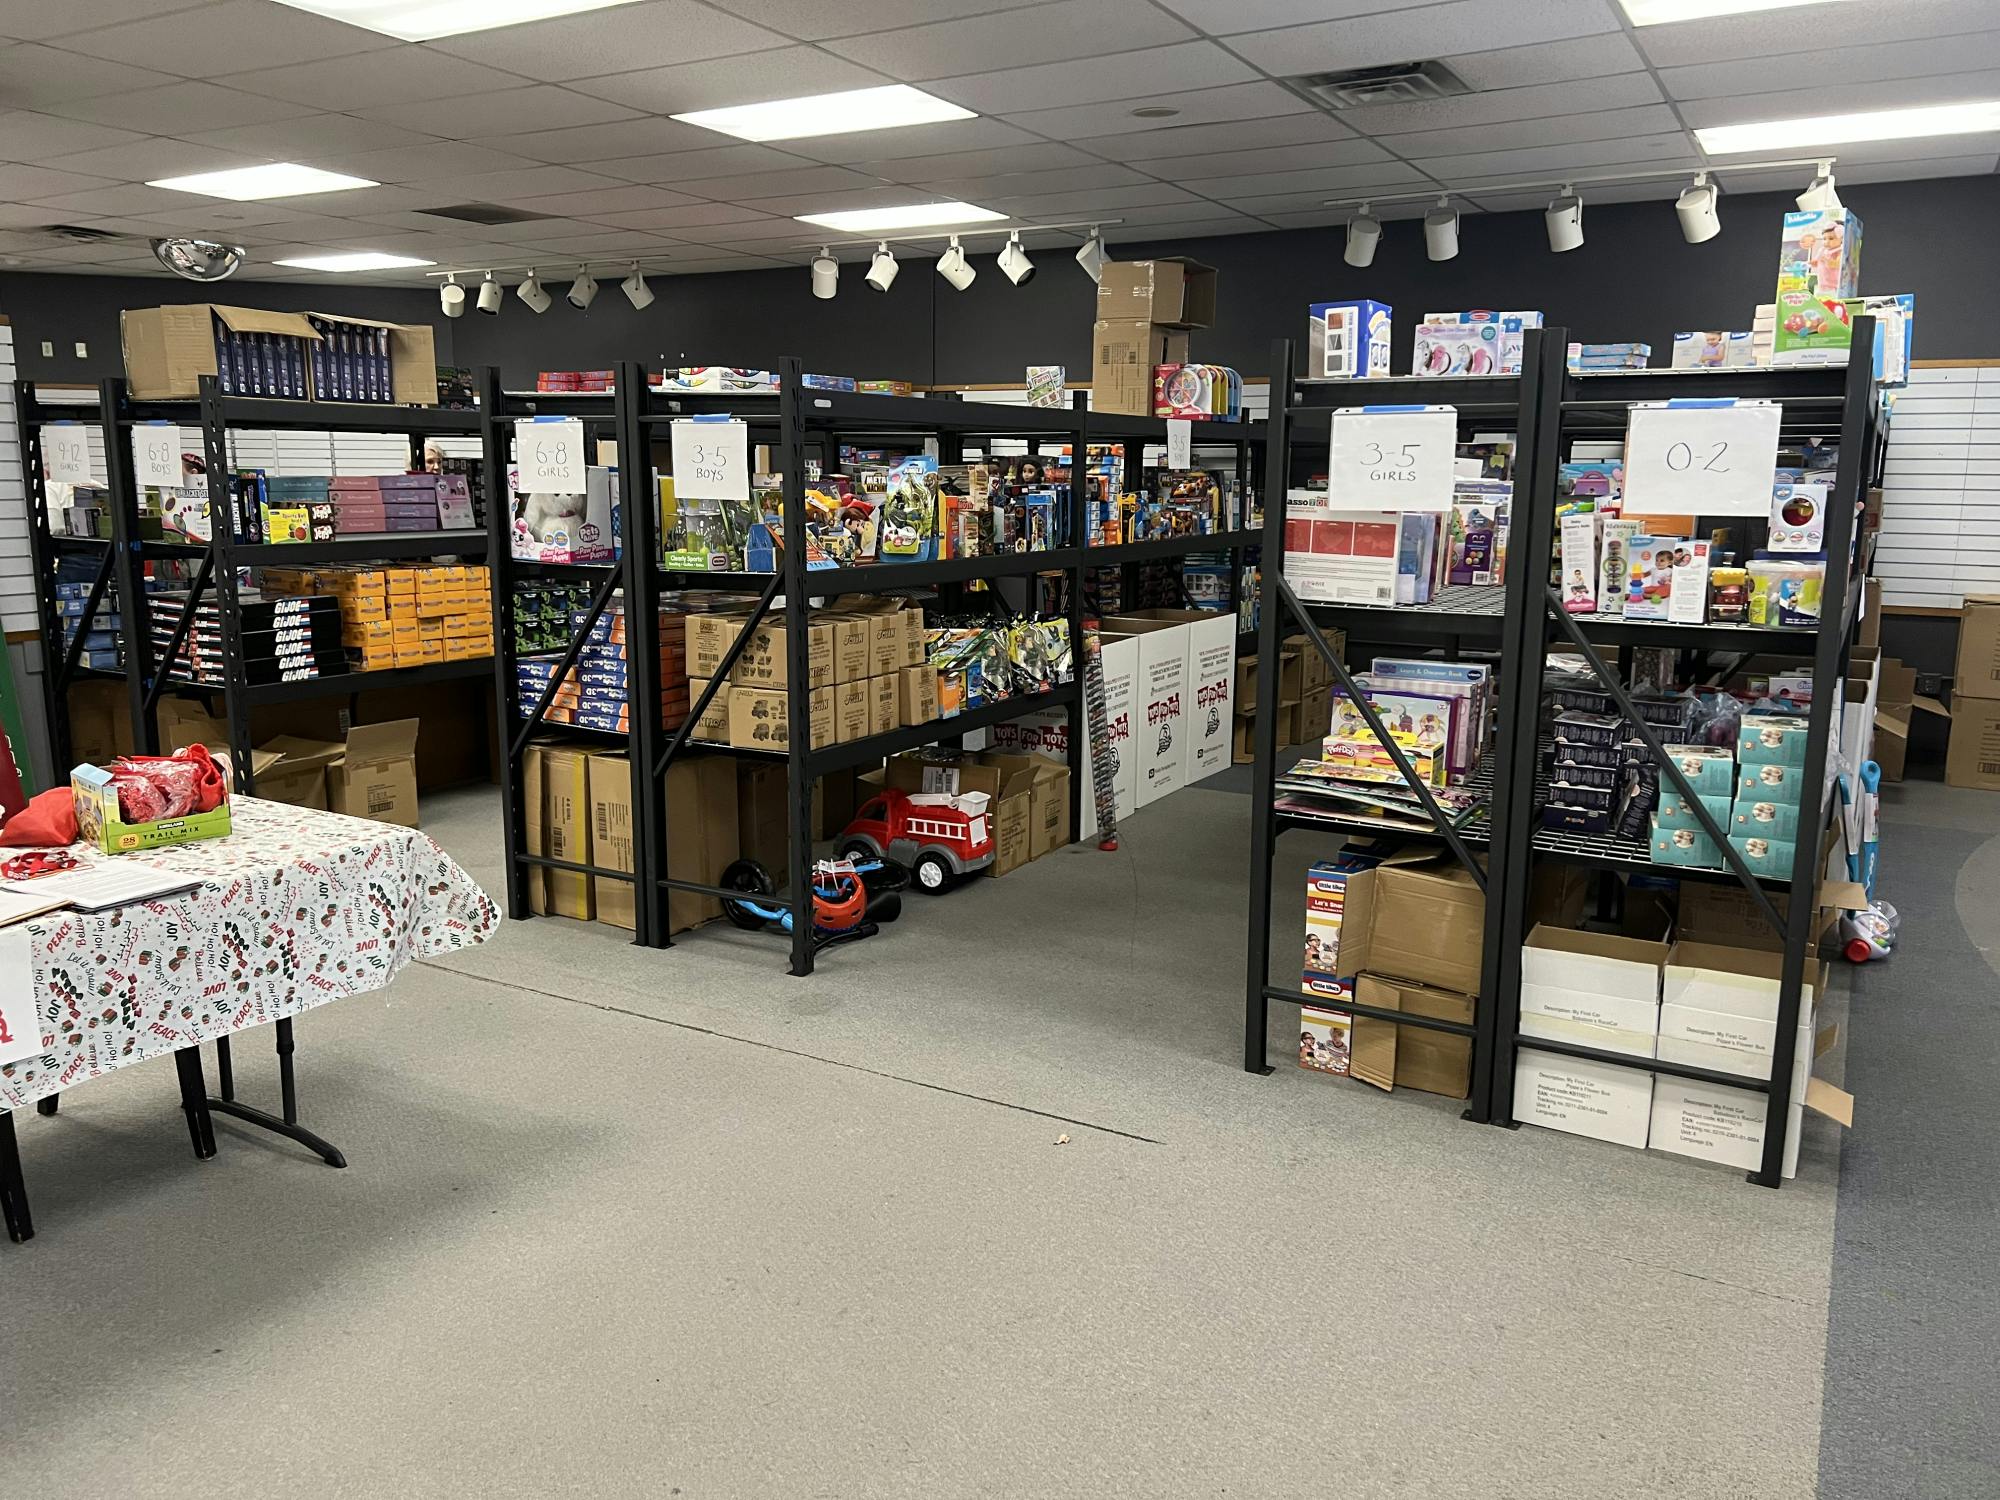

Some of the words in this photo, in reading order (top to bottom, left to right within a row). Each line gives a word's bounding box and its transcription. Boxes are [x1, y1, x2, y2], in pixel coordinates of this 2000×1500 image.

[1033, 373, 1050, 385] Farm
[58, 441, 82, 463] 9-12
[148, 442, 170, 463] 6-8
[536, 441, 567, 465] 6-8
[690, 444, 732, 468] 3-5
[1360, 442, 1422, 468] 3-5
[151, 463, 171, 475] BOYS
[537, 466, 570, 478] GIRLS
[696, 468, 724, 483] BOYS
[1370, 470, 1417, 482] GIRLS
[312, 504, 333, 520] Jenga
[313, 525, 333, 540] Jenga
[580, 527, 599, 537] Pets
[687, 555, 702, 563] Sports
[995, 727, 1017, 739] TOYS
[1022, 731, 1039, 743] FOR
[1044, 734, 1068, 747] TOTS
[143, 830, 175, 840] TRAIL
[180, 826, 200, 834] MIX
[364, 844, 382, 870] PEACE
[436, 860, 448, 877] JOY
[221, 879, 242, 908] PEACE
[319, 881, 329, 899] JOY
[368, 909, 381, 929] JOY
[466, 908, 479, 921] JOY
[166, 922, 178, 941] JOY
[444, 919, 467, 931] LOVE
[46, 921, 73, 954] PEACE
[355, 939, 379, 952] LOVE
[450, 932, 461, 948] JOY
[218, 950, 232, 971] JOY
[366, 955, 386, 970] JOY
[105, 967, 125, 983] LOVE
[306, 974, 336, 992] PEACE
[203, 982, 226, 997] LOVE
[1313, 981, 1325, 989] little
[1326, 983, 1339, 991] tikes
[46, 999, 61, 1023] JOY
[213, 999, 232, 1014] JOY
[232, 999, 253, 1029] PEACE
[148, 1022, 180, 1041] PEACE
[39, 1054, 61, 1070] JOY
[60, 1053, 86, 1085] PEACE
